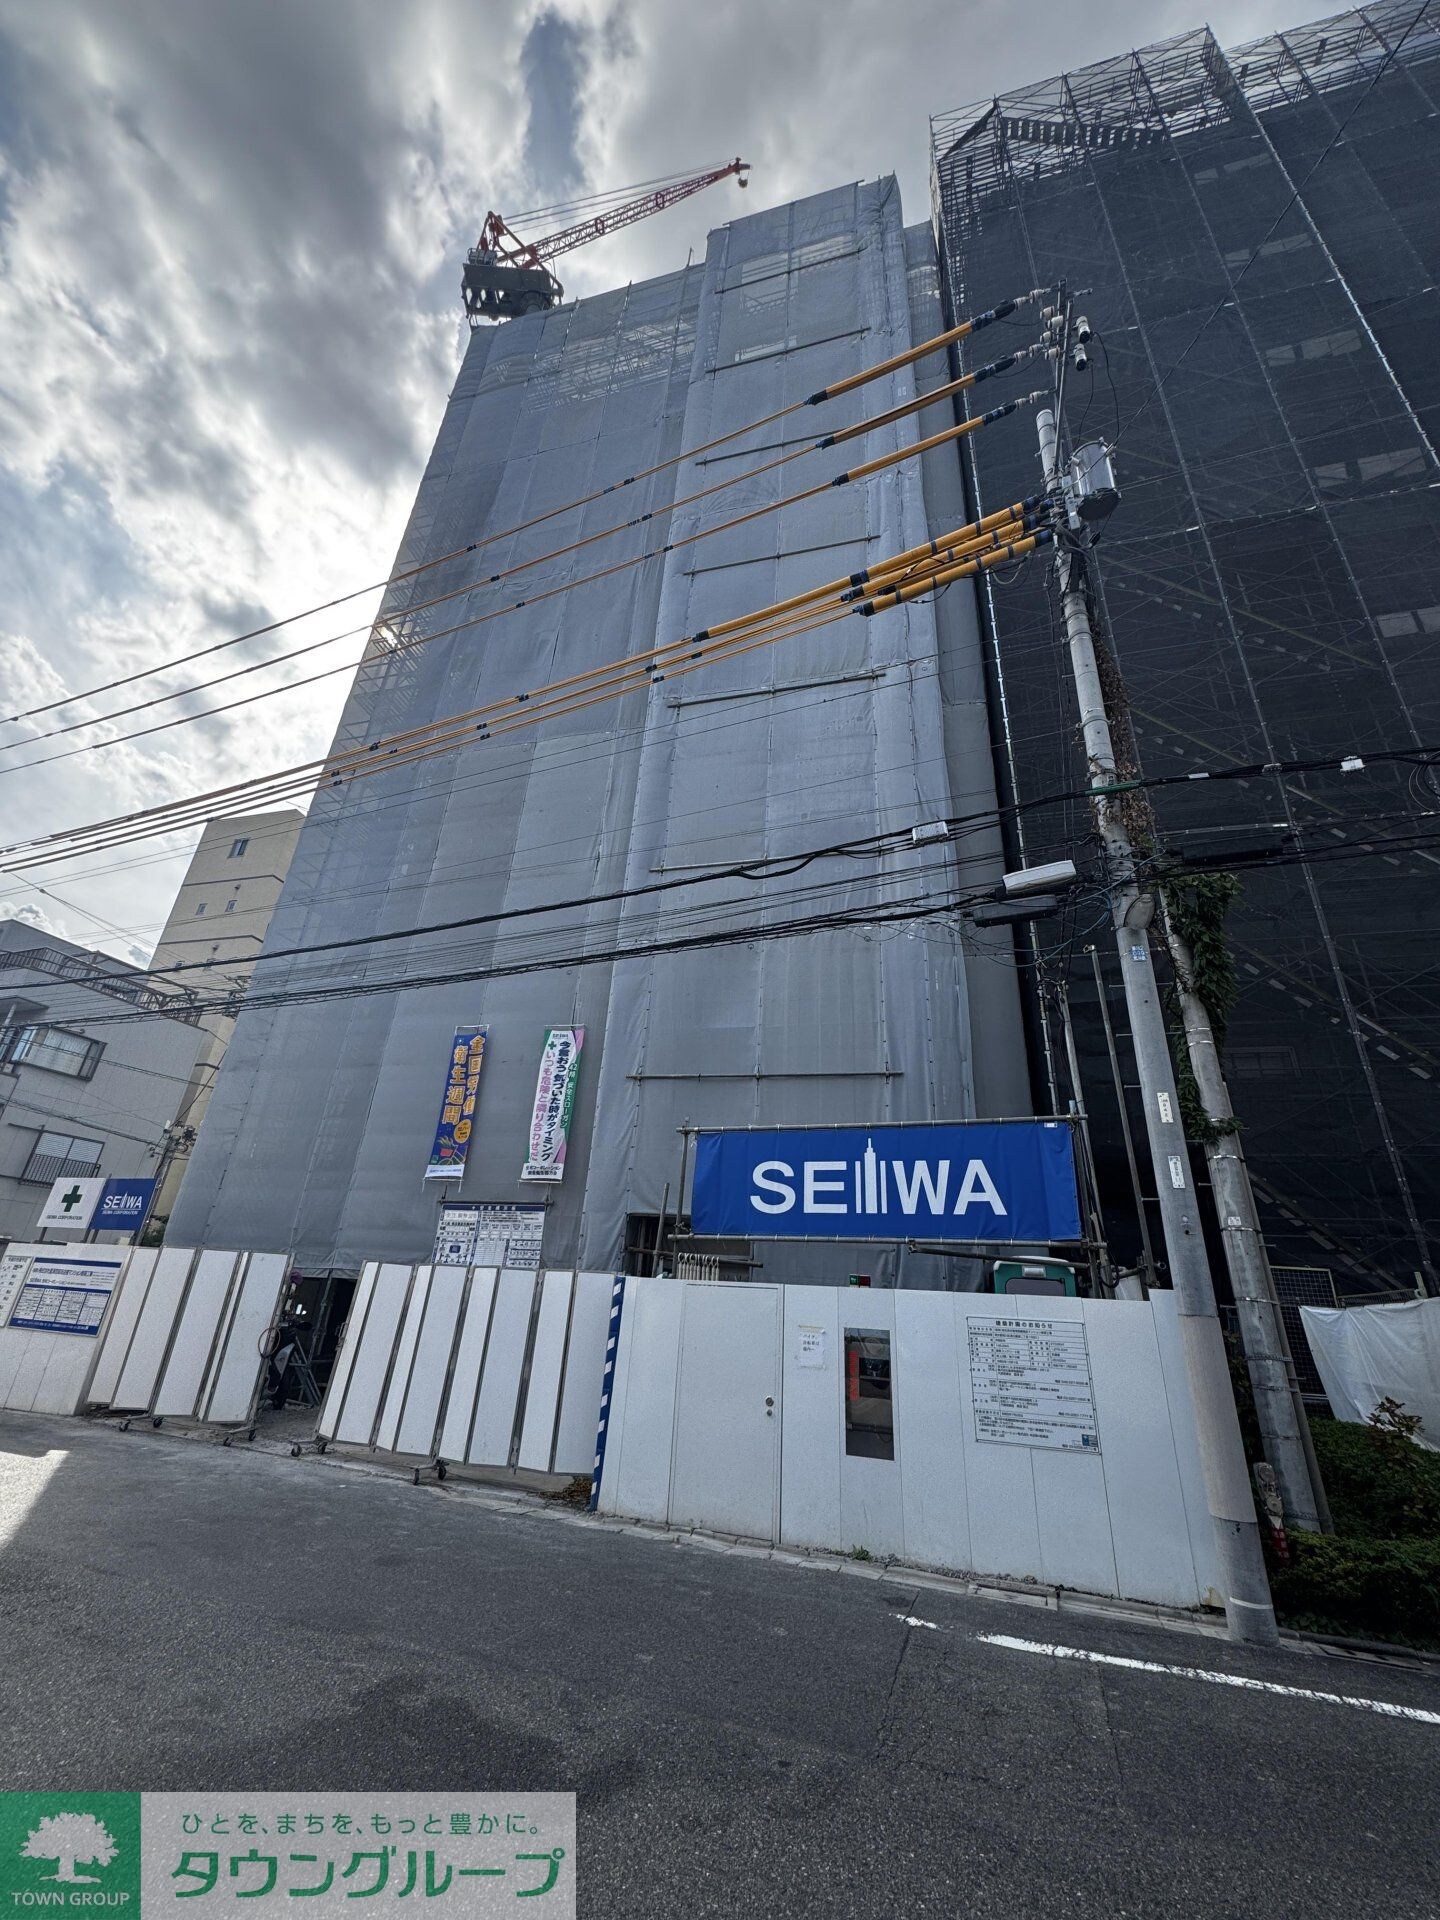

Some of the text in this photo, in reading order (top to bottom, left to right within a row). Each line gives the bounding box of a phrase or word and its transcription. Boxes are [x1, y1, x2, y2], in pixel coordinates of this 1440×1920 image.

[442, 1044, 469, 1125] 衛生週間
[103, 1191, 142, 1209] SEIWA
[750, 1138, 1008, 1216] SEIWA
